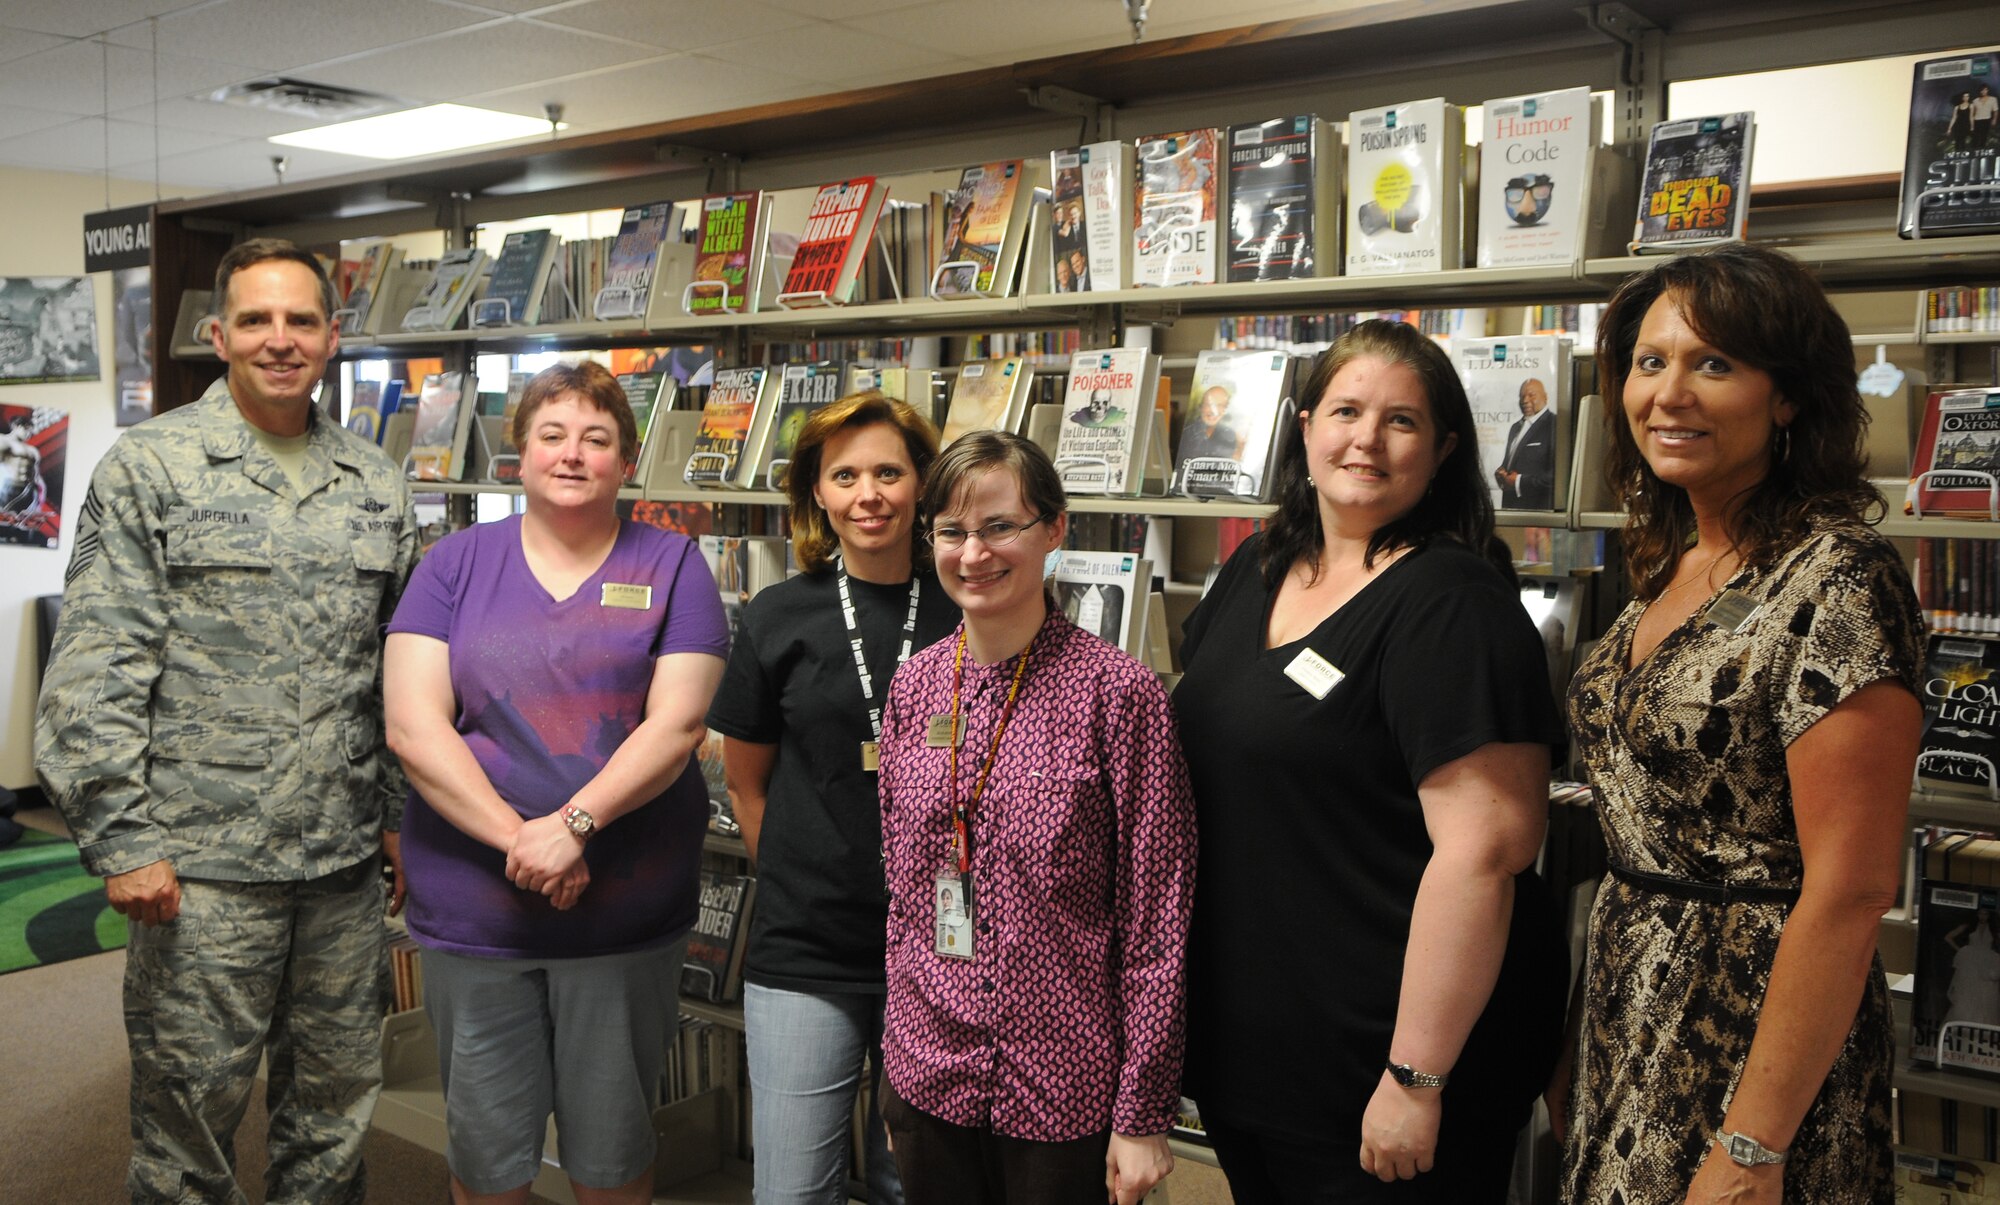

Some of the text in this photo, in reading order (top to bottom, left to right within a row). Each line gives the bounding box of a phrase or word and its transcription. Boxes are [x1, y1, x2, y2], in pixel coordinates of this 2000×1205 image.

[1496, 116, 1573, 140] Humor
[1361, 129, 1392, 152] POISON
[1232, 148, 1262, 163] FORCING
[1505, 141, 1560, 164] Code
[1664, 176, 1719, 191] THROUGH
[810, 184, 868, 216] STEPHEN
[1650, 184, 1732, 217] DEAD
[707, 217, 745, 236] WITTIG
[800, 210, 858, 243] HUNTER
[1667, 208, 1726, 231] EYES
[86, 224, 133, 255] YOUNG
[702, 233, 744, 253] ALBERT
[782, 268, 836, 294] HONOR
[1499, 353, 1540, 369] Jakes
[716, 371, 754, 389] JAMES
[789, 374, 838, 403] KERR
[1073, 374, 1134, 391] POISONER
[709, 387, 756, 404] ROLLINS
[1473, 411, 1513, 424] TINCT
[1944, 416, 2000, 431] OXFOR
[710, 439, 739, 455] KILL
[1187, 471, 1219, 482] Smart
[187, 510, 250, 525] JURGELLA
[1925, 678, 2000, 706] CLOA
[1939, 702, 1998, 726] LIGH
[1919, 756, 1989, 779] BLACK
